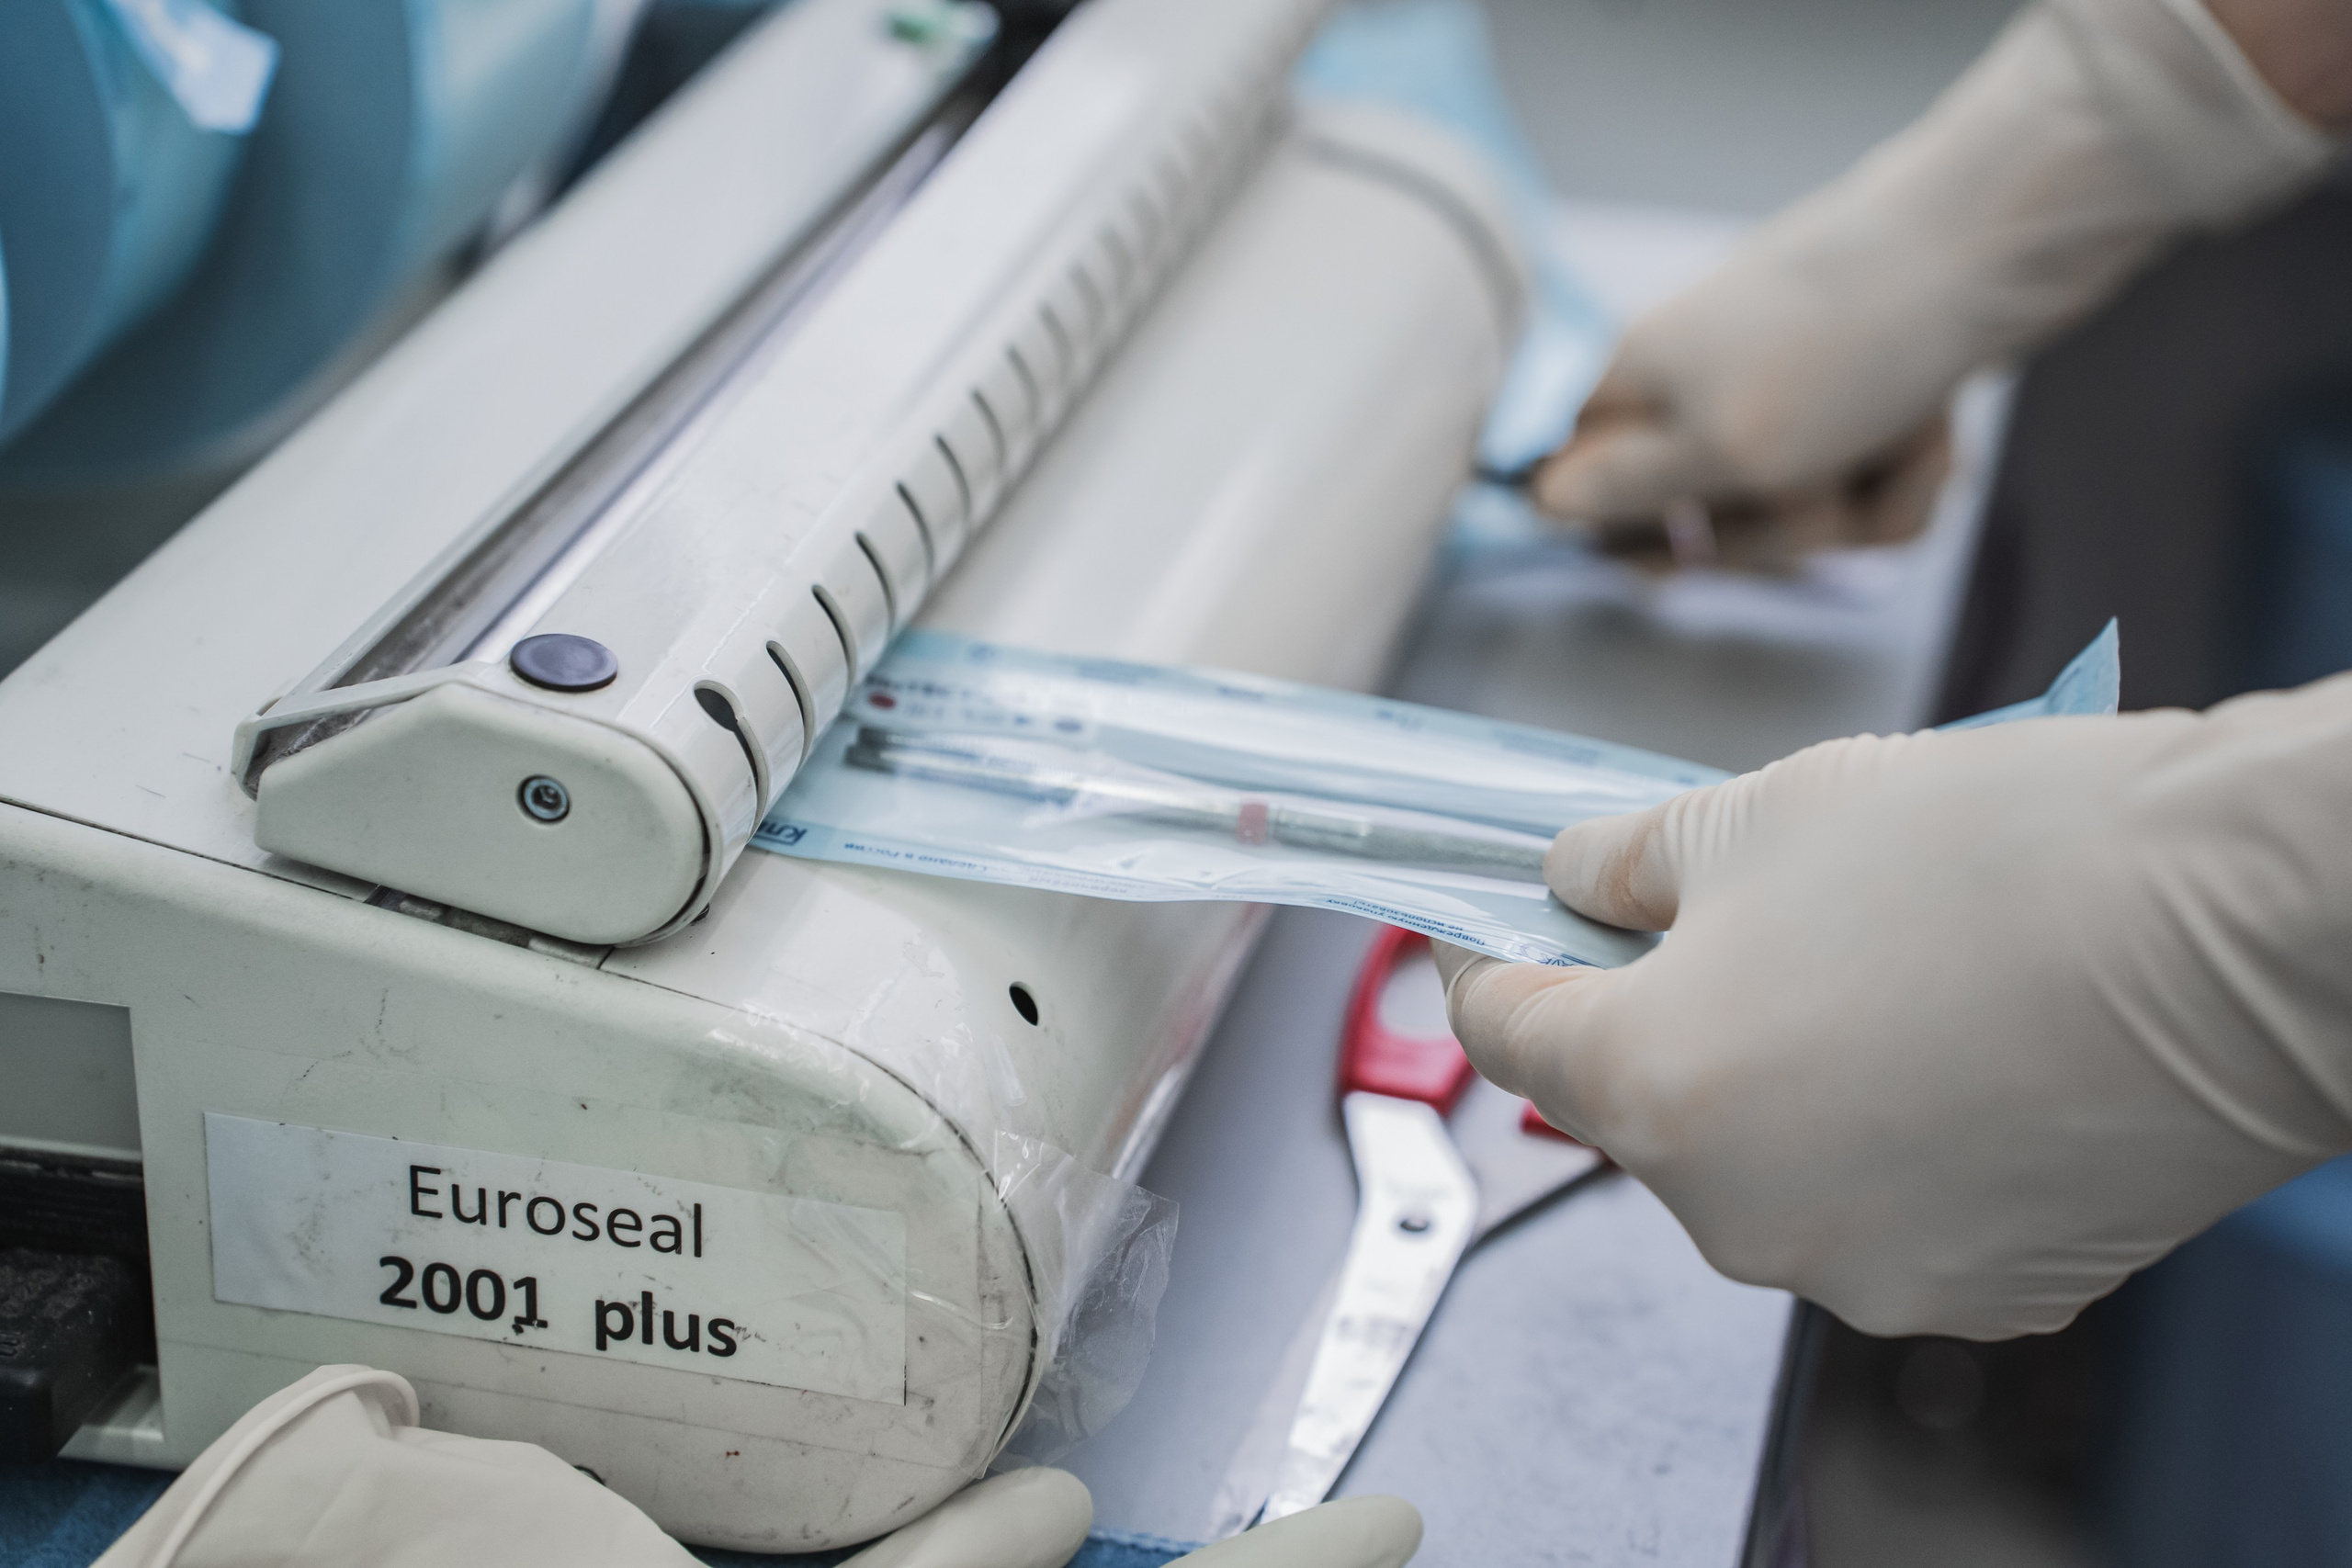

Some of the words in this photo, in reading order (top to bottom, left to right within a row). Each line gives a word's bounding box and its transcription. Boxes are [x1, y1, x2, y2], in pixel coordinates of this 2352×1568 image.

[1326, 898, 1385, 917] упаковку
[1387, 915, 1486, 946] Поврежденную
[410, 1165, 703, 1258] Euroseal
[379, 1255, 548, 1328] 2001
[594, 1291, 738, 1358] plus
